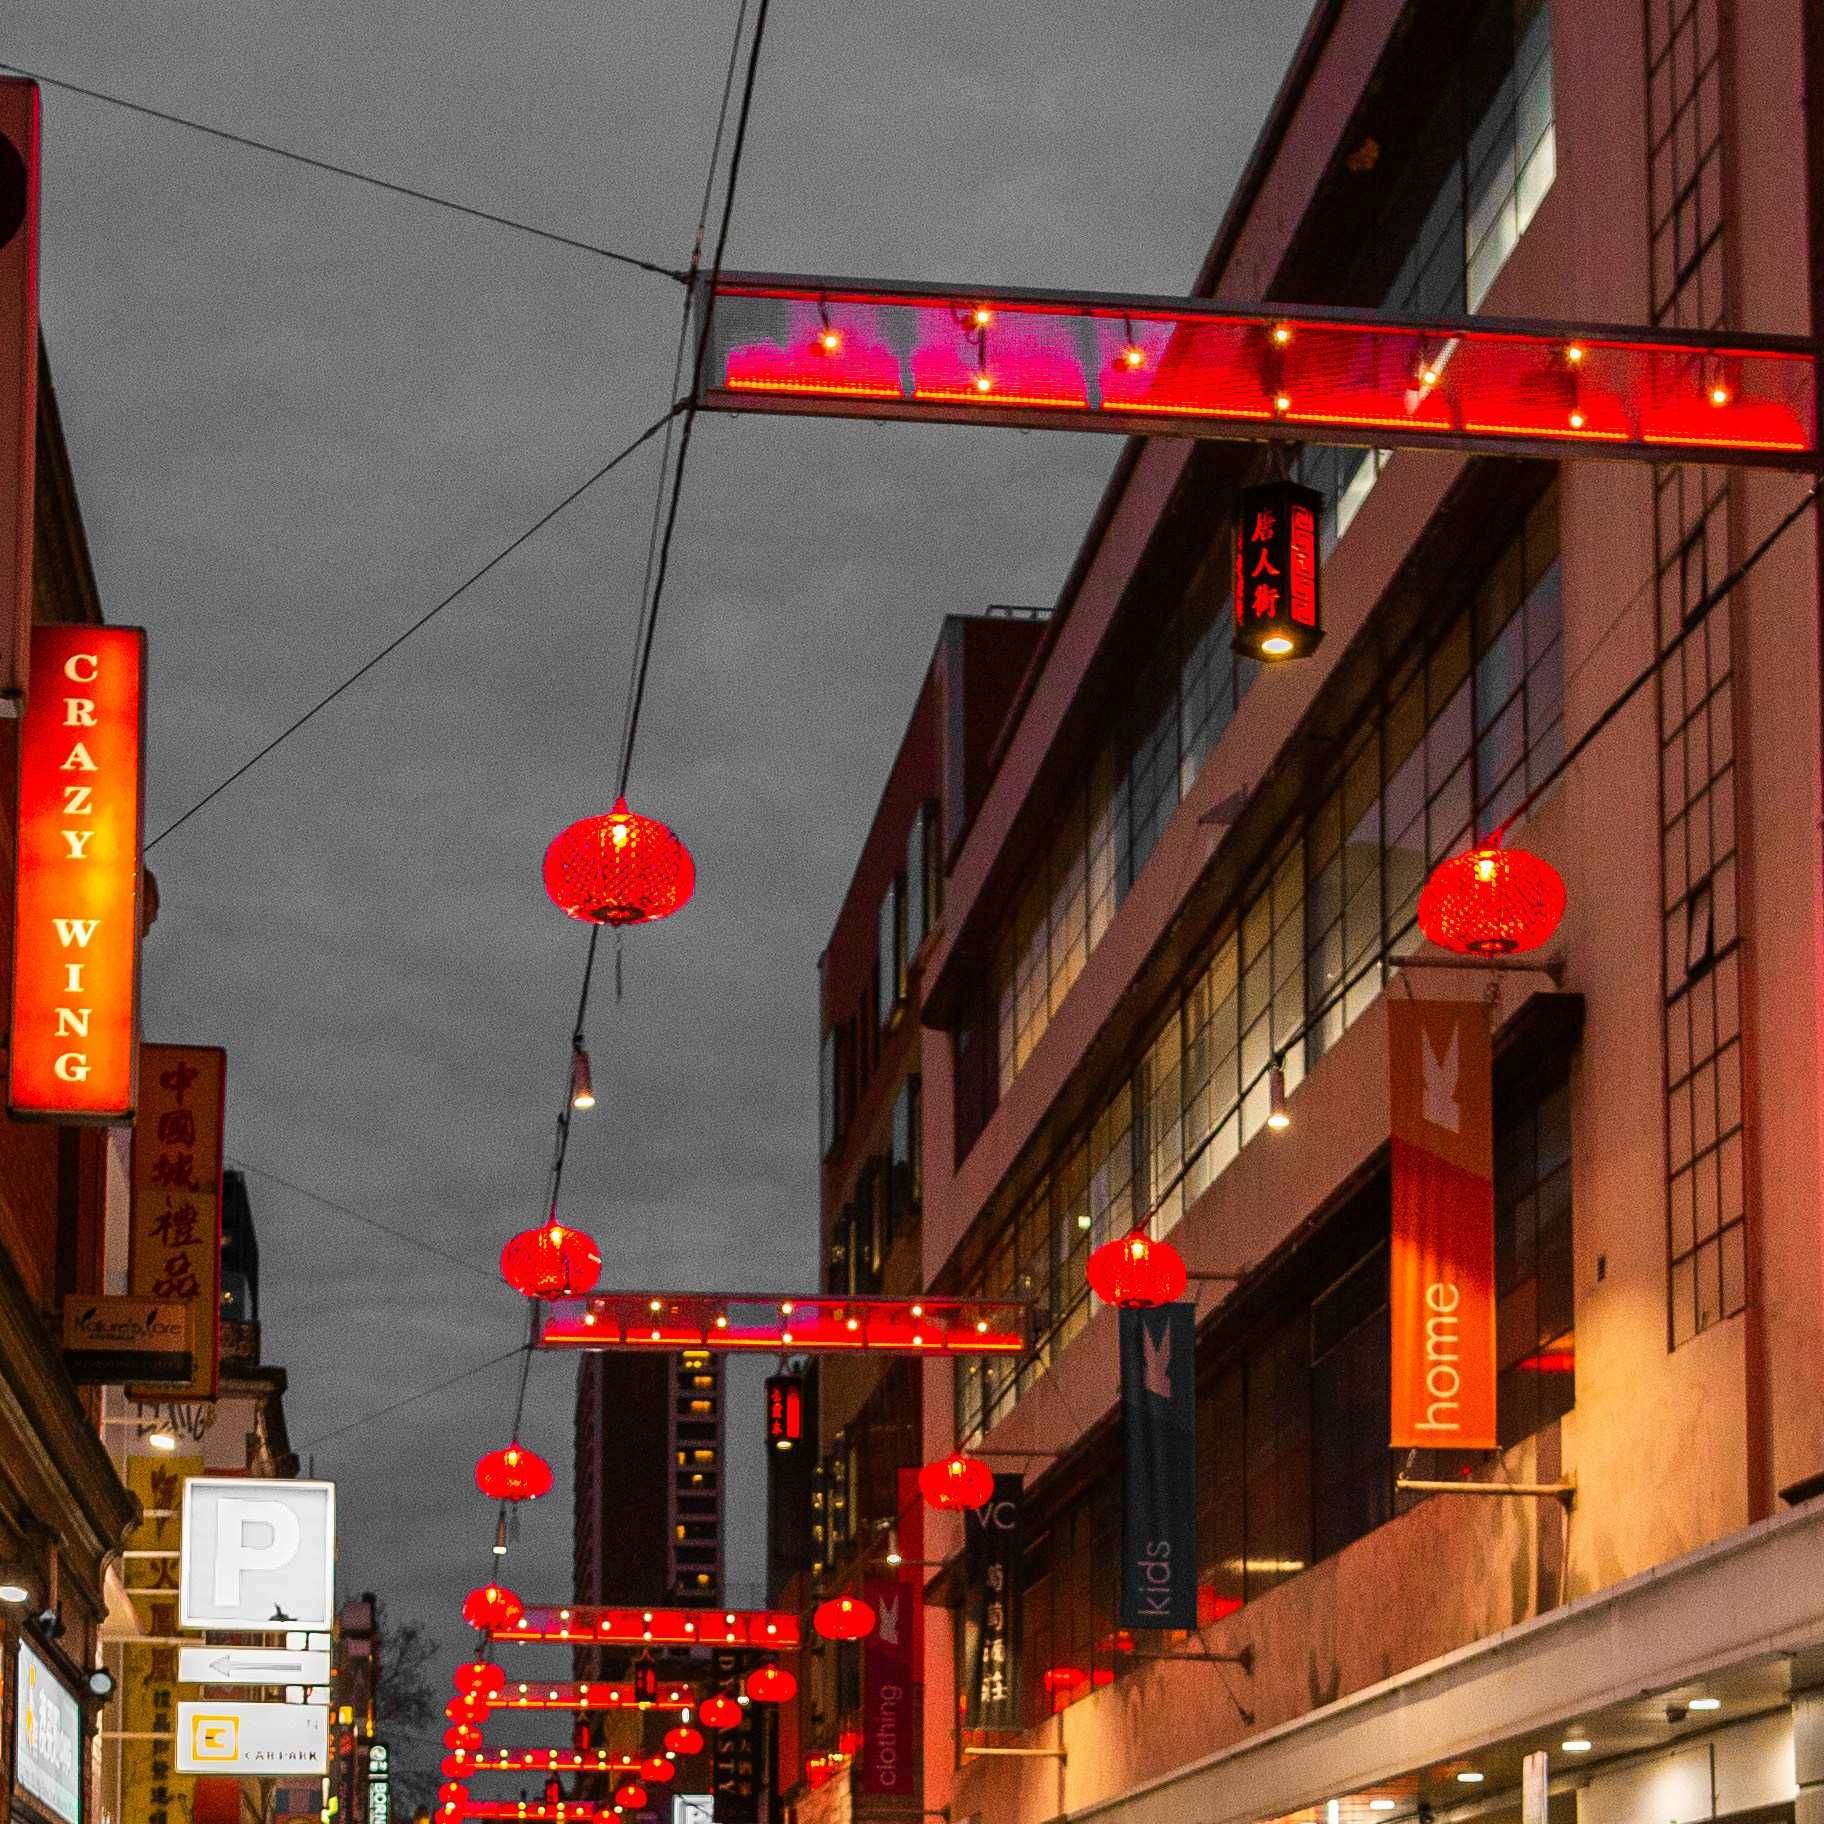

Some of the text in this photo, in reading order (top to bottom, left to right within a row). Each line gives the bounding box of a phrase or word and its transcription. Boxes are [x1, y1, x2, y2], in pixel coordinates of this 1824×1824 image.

[52, 653, 100, 1082] CRAZY WING
[1414, 1281, 1460, 1432] home
[214, 1497, 300, 1607] P
[1136, 1538, 1172, 1617] kids
[876, 1685, 903, 1787] clothing
